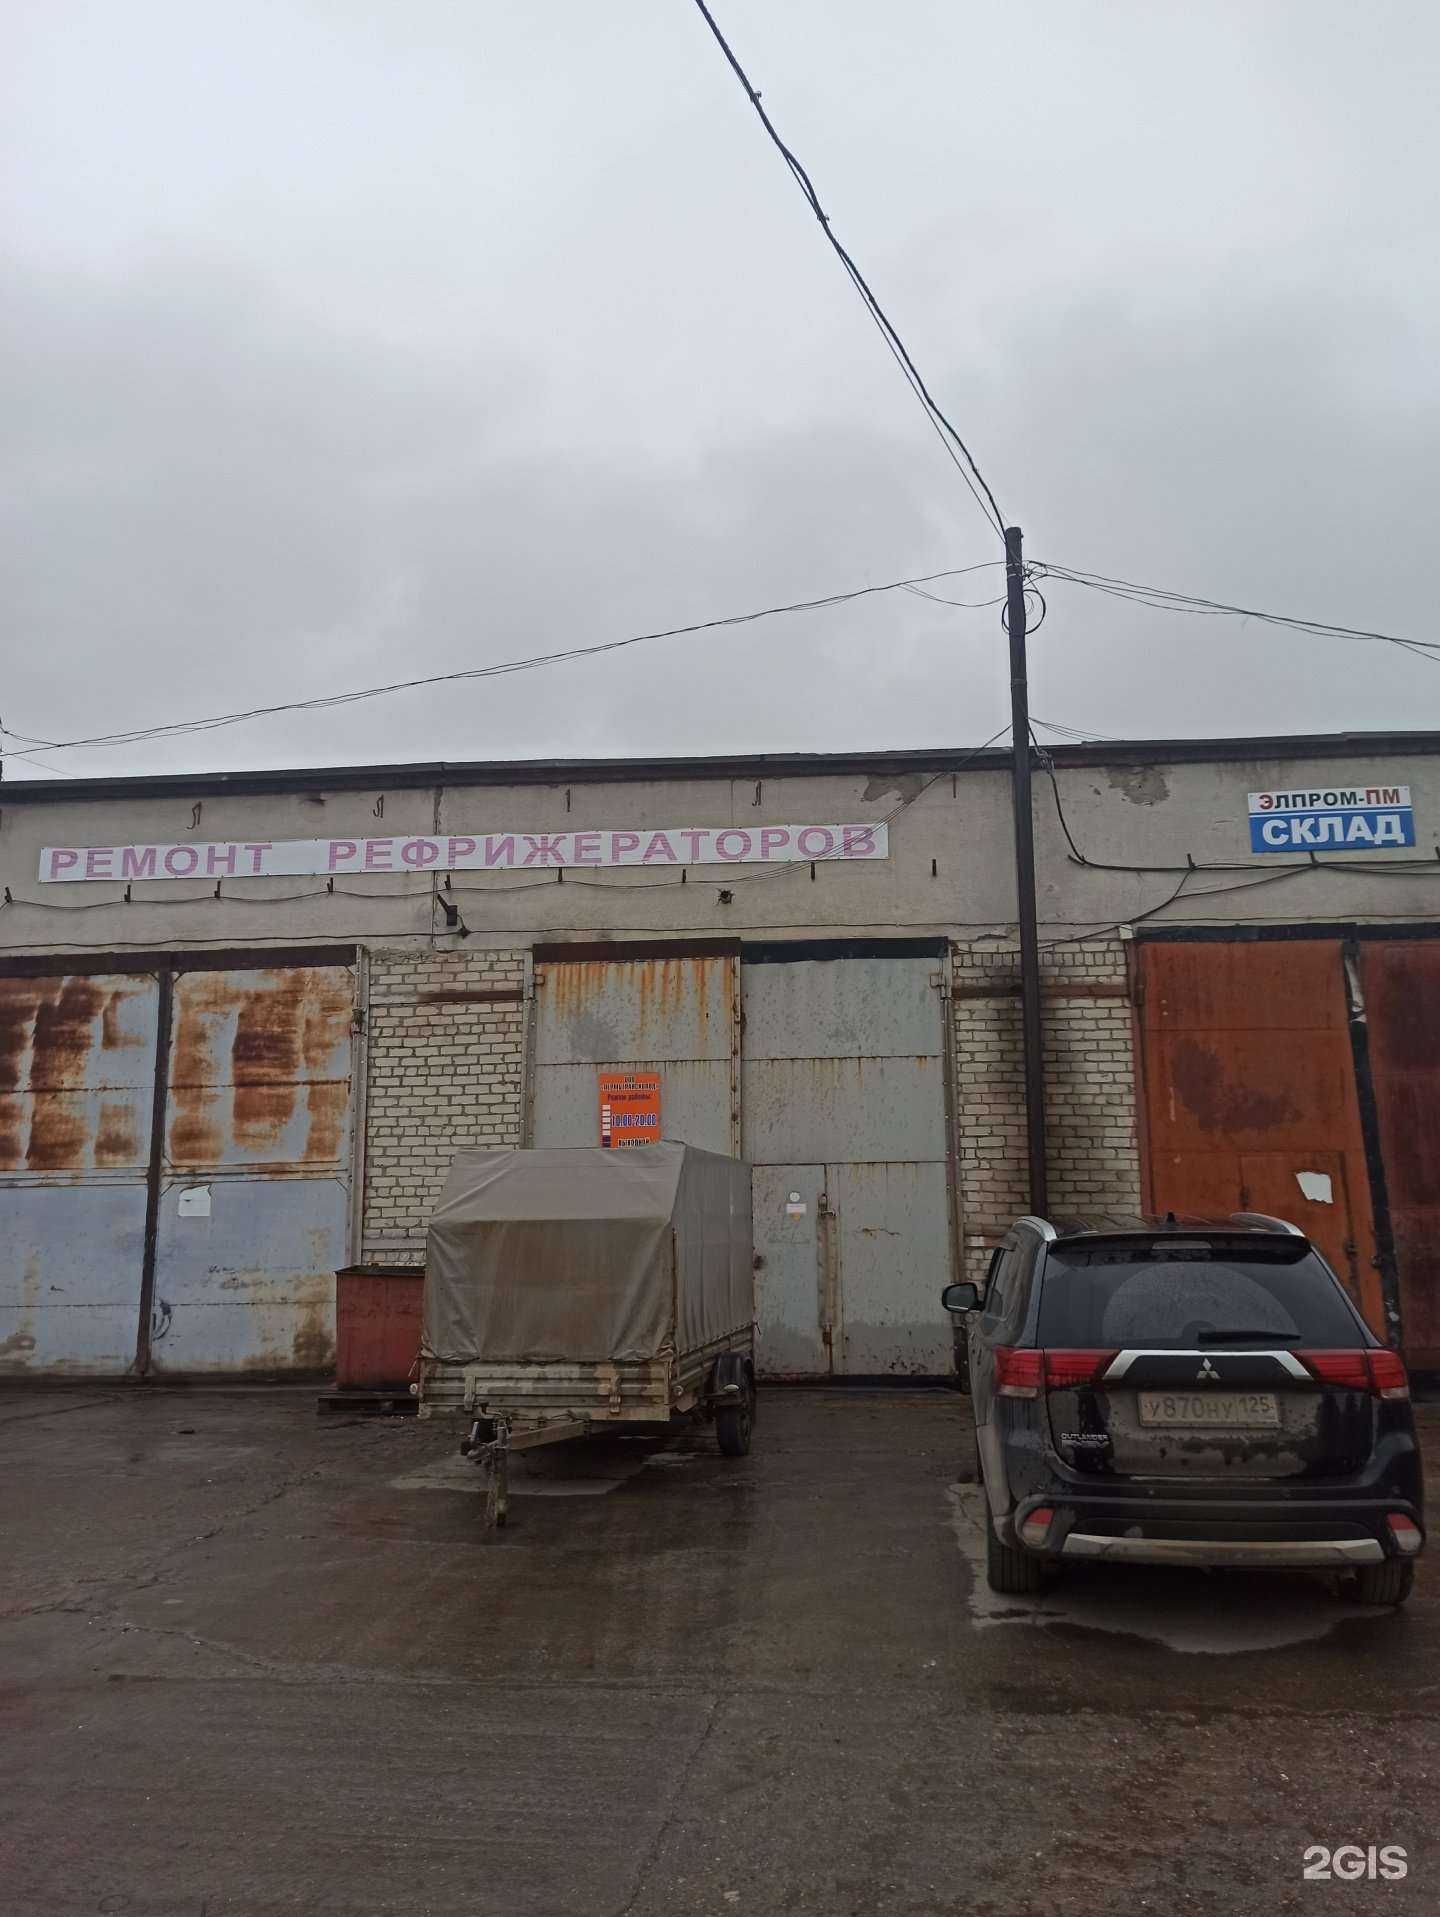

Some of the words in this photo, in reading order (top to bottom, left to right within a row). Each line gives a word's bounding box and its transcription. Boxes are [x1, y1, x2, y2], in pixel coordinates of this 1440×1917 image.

[1259, 789, 1400, 810] ЭЛПРОМ-ПМ
[1262, 815, 1405, 845] СКЛАД
[50, 844, 272, 879] РЕМОНТ
[328, 826, 877, 870] РЕФРИЖЕРАТОРОВ
